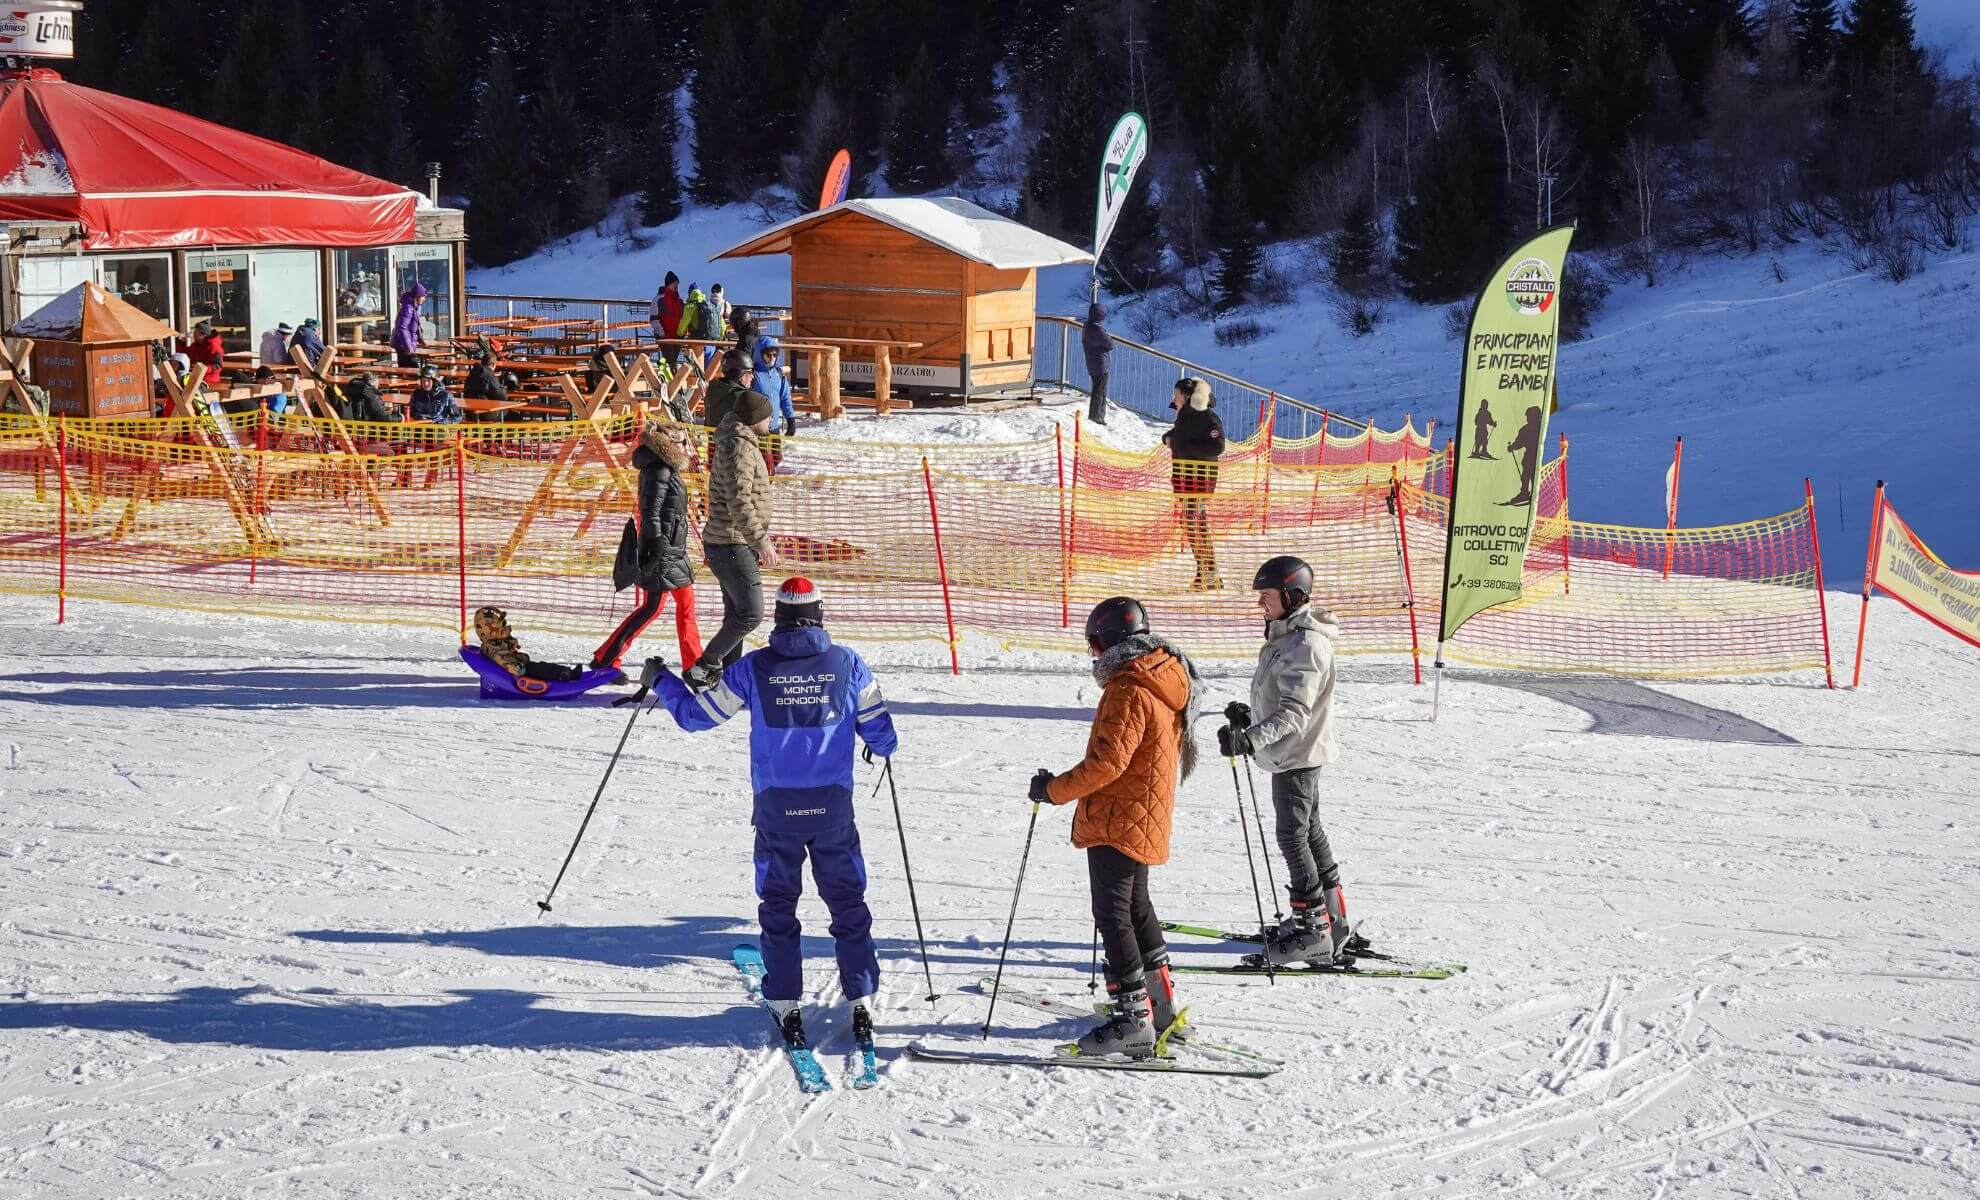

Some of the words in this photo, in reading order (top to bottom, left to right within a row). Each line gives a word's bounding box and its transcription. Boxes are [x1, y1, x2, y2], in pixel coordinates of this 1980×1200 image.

[1507, 282, 1555, 292] CRISTALLO
[1477, 354, 1487, 370] E
[1489, 353, 1549, 371] INTERME
[1453, 525, 1506, 537] RITROVO
[1489, 554, 1509, 566] SCI
[769, 674, 815, 684] SCUOLA
[817, 673, 836, 682] SCI
[783, 685, 822, 694] MONTE
[775, 695, 831, 705] BONDONE
[785, 807, 826, 816] MAESTRO
[1125, 1041, 1153, 1049] HEAD
